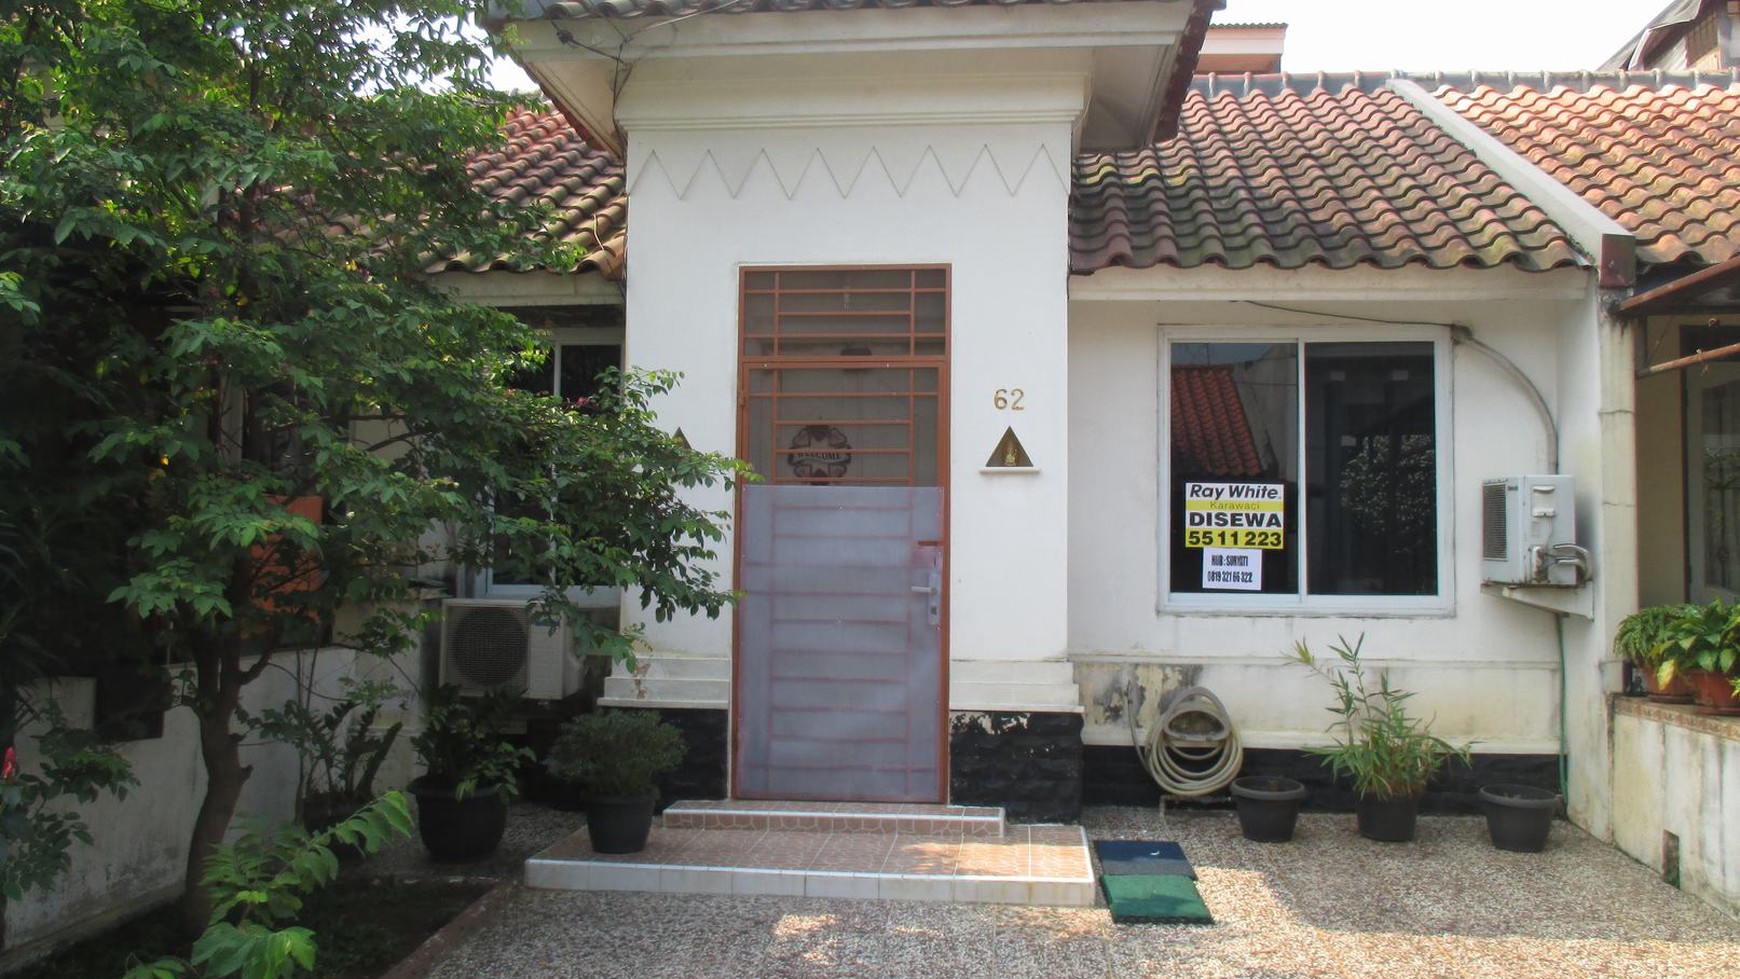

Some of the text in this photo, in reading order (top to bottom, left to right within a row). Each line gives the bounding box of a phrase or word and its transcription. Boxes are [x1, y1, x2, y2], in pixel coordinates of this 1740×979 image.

[994, 388, 1024, 411] 62
[1190, 484, 1278, 500] Ray White
[1210, 501, 1260, 510] Karawaci
[1189, 512, 1282, 527] DISEWA
